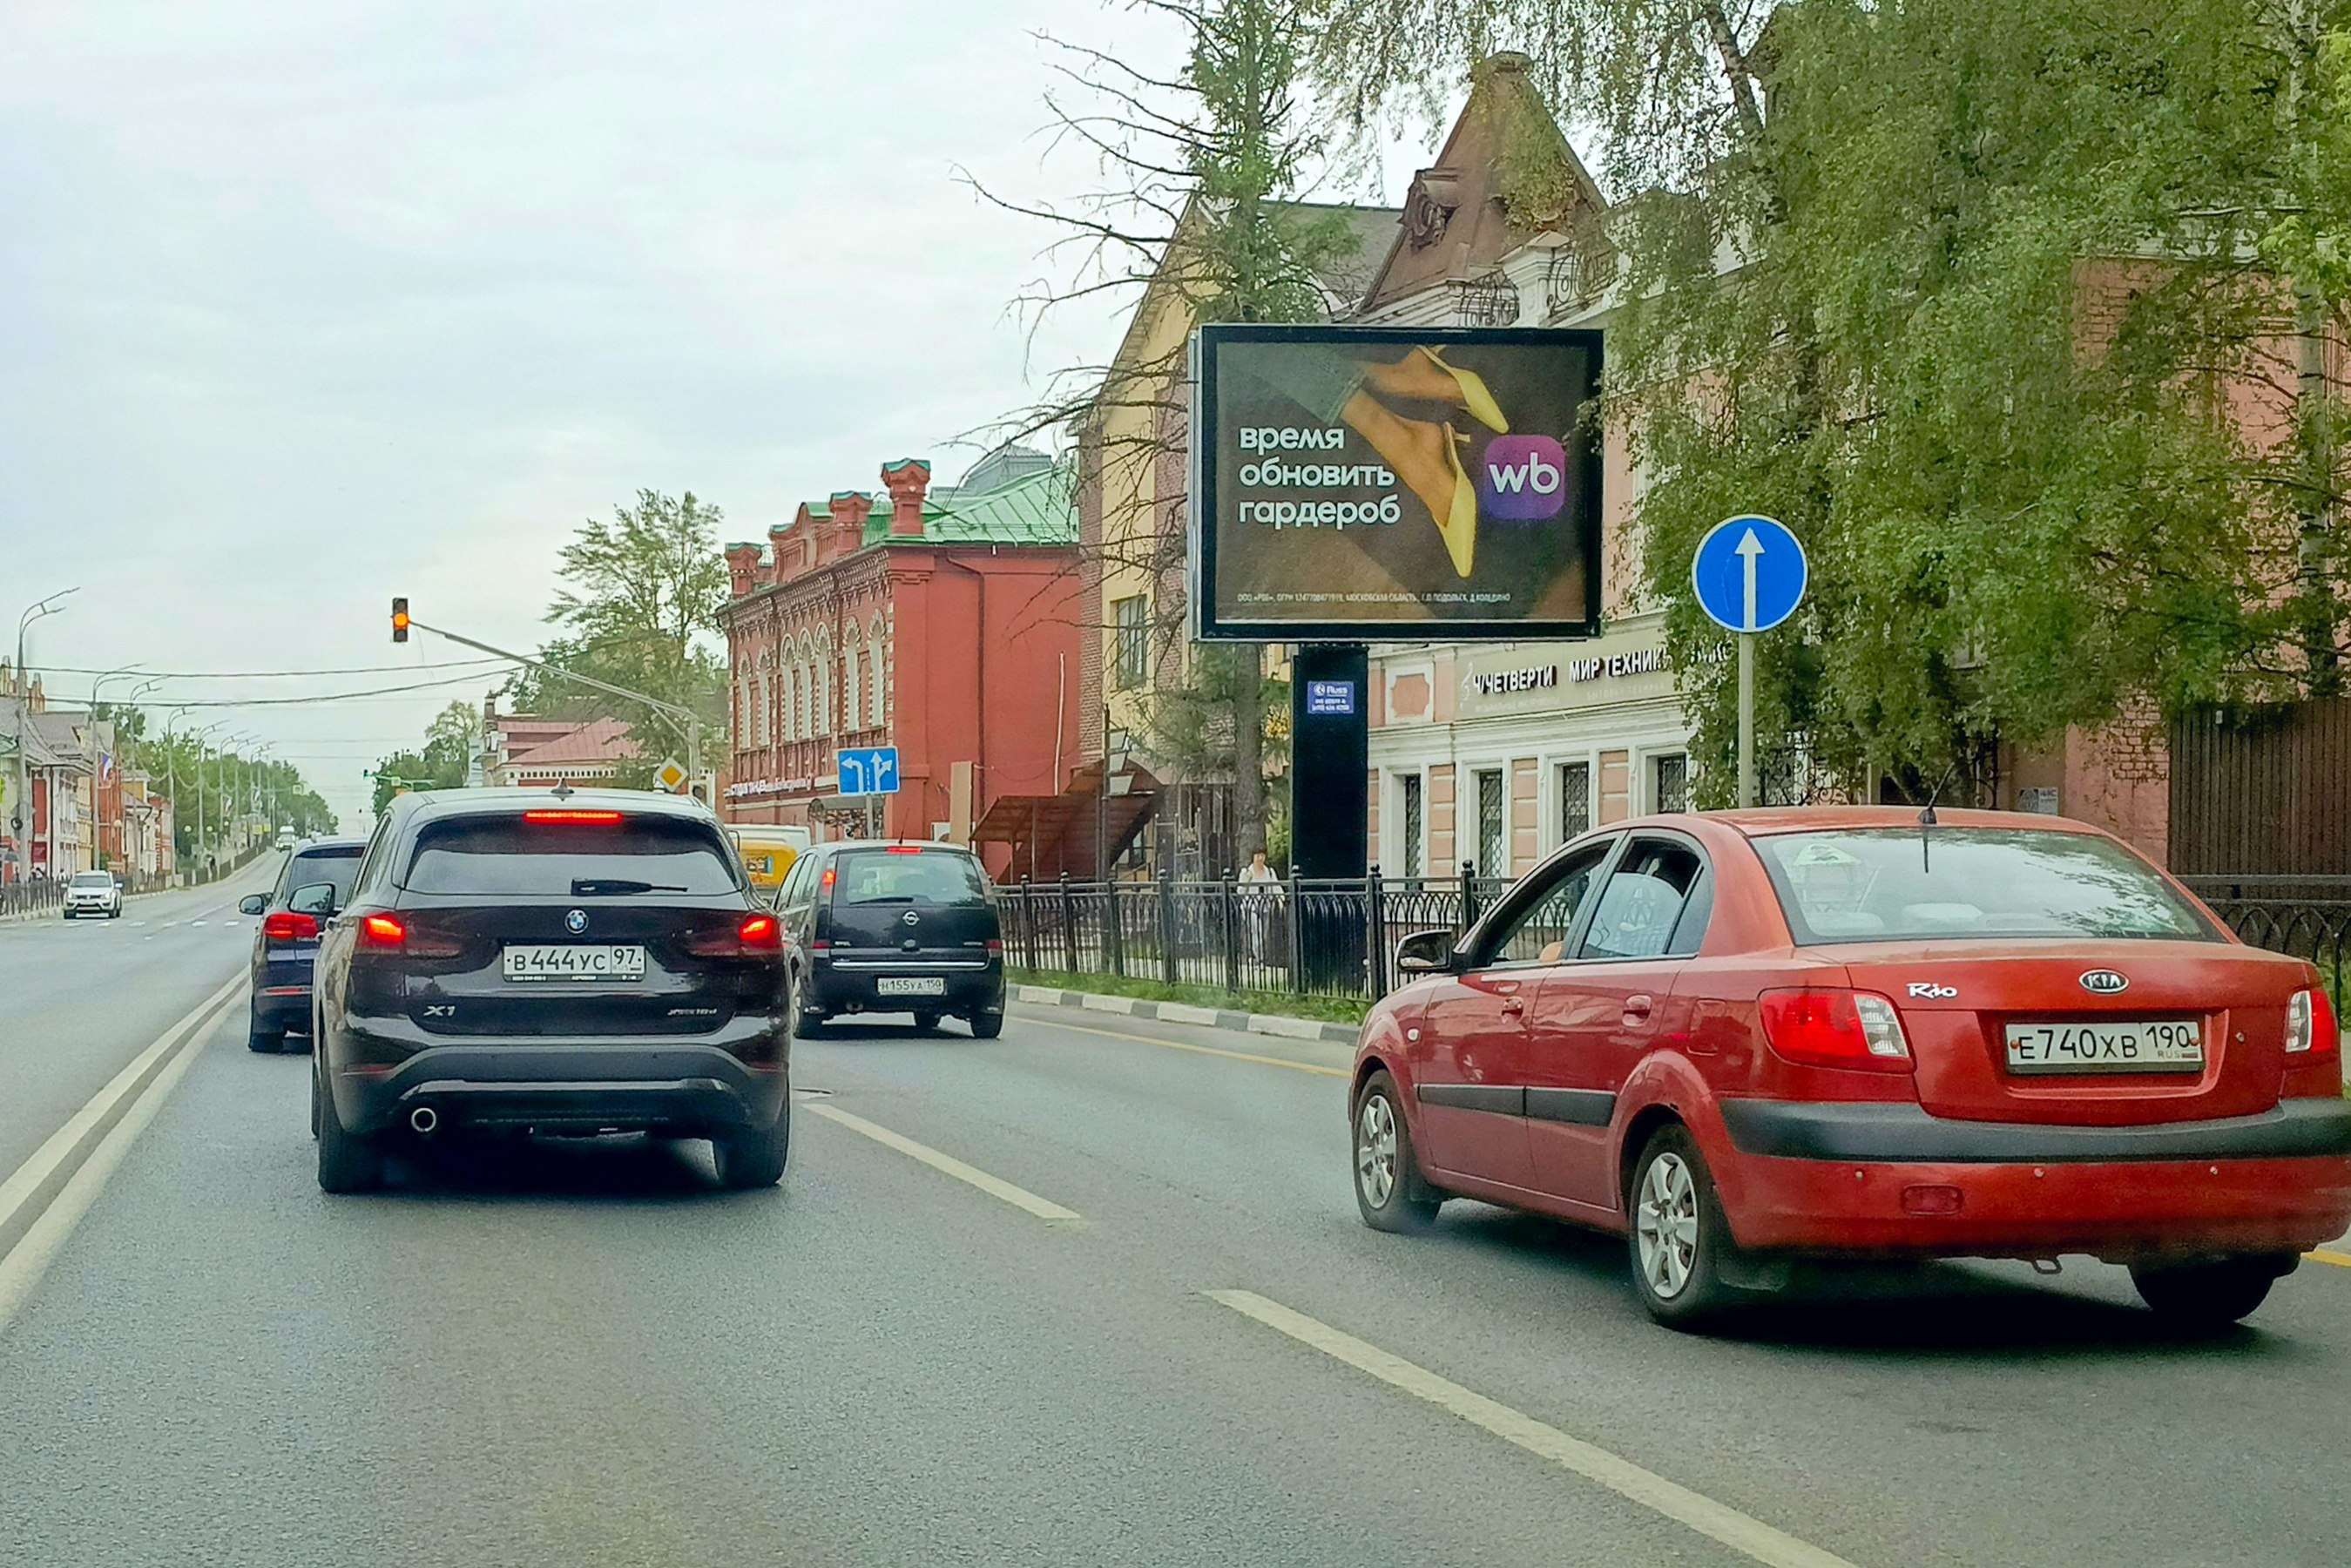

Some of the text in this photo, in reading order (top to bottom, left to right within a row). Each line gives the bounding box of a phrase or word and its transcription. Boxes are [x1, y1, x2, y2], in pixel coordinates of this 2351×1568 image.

[1239, 427, 1345, 456] время
[1239, 457, 1395, 486] обновить
[1488, 451, 1560, 495] wb
[1239, 495, 1401, 530] гардероб
[1237, 593, 1253, 602] ООО
[1569, 657, 1600, 682] МИР
[514, 948, 636, 971] В444УС 97
[1906, 983, 1958, 999] Rio
[2088, 974, 2121, 988] KIA
[423, 1005, 456, 1017] X1
[2017, 1025, 2190, 1060] Е740ХВ 190
[2157, 1050, 2181, 1058] RUS
